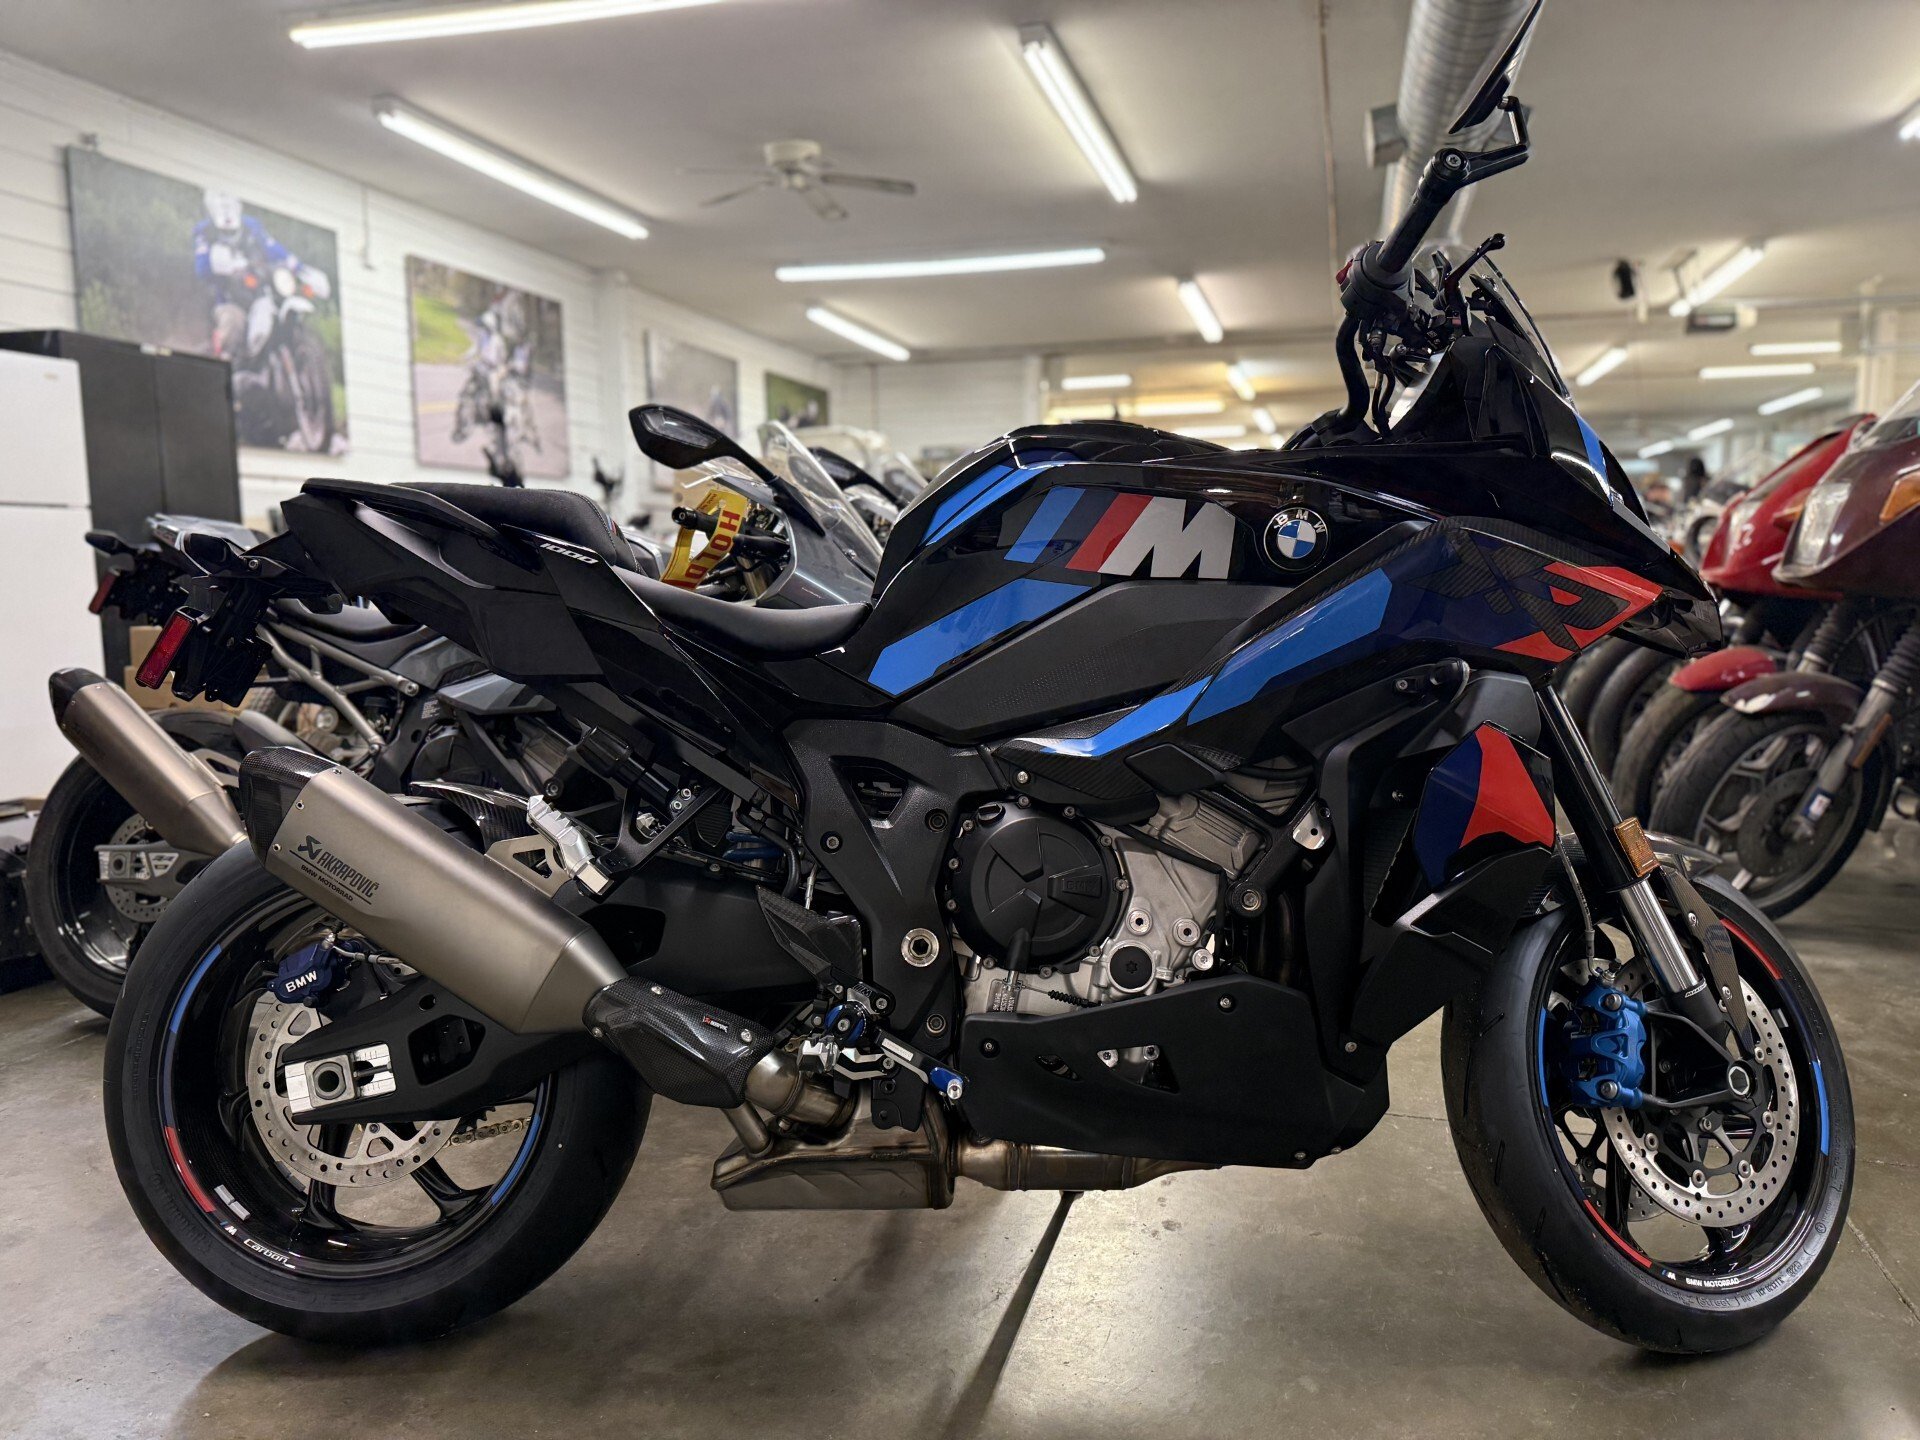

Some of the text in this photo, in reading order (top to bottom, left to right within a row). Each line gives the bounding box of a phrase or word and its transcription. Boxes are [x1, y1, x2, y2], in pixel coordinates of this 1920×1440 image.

[1273, 509, 1326, 533] BMW
[540, 542, 599, 565] 1000
[301, 864, 318, 878] BMW
[317, 875, 354, 901] MOTORRAD
[317, 851, 380, 898] AKRAPOVIČ
[285, 970, 318, 993] BMW
[1686, 1277, 1703, 1288] BMW
[1703, 1276, 1740, 1288] MOTORRAD
